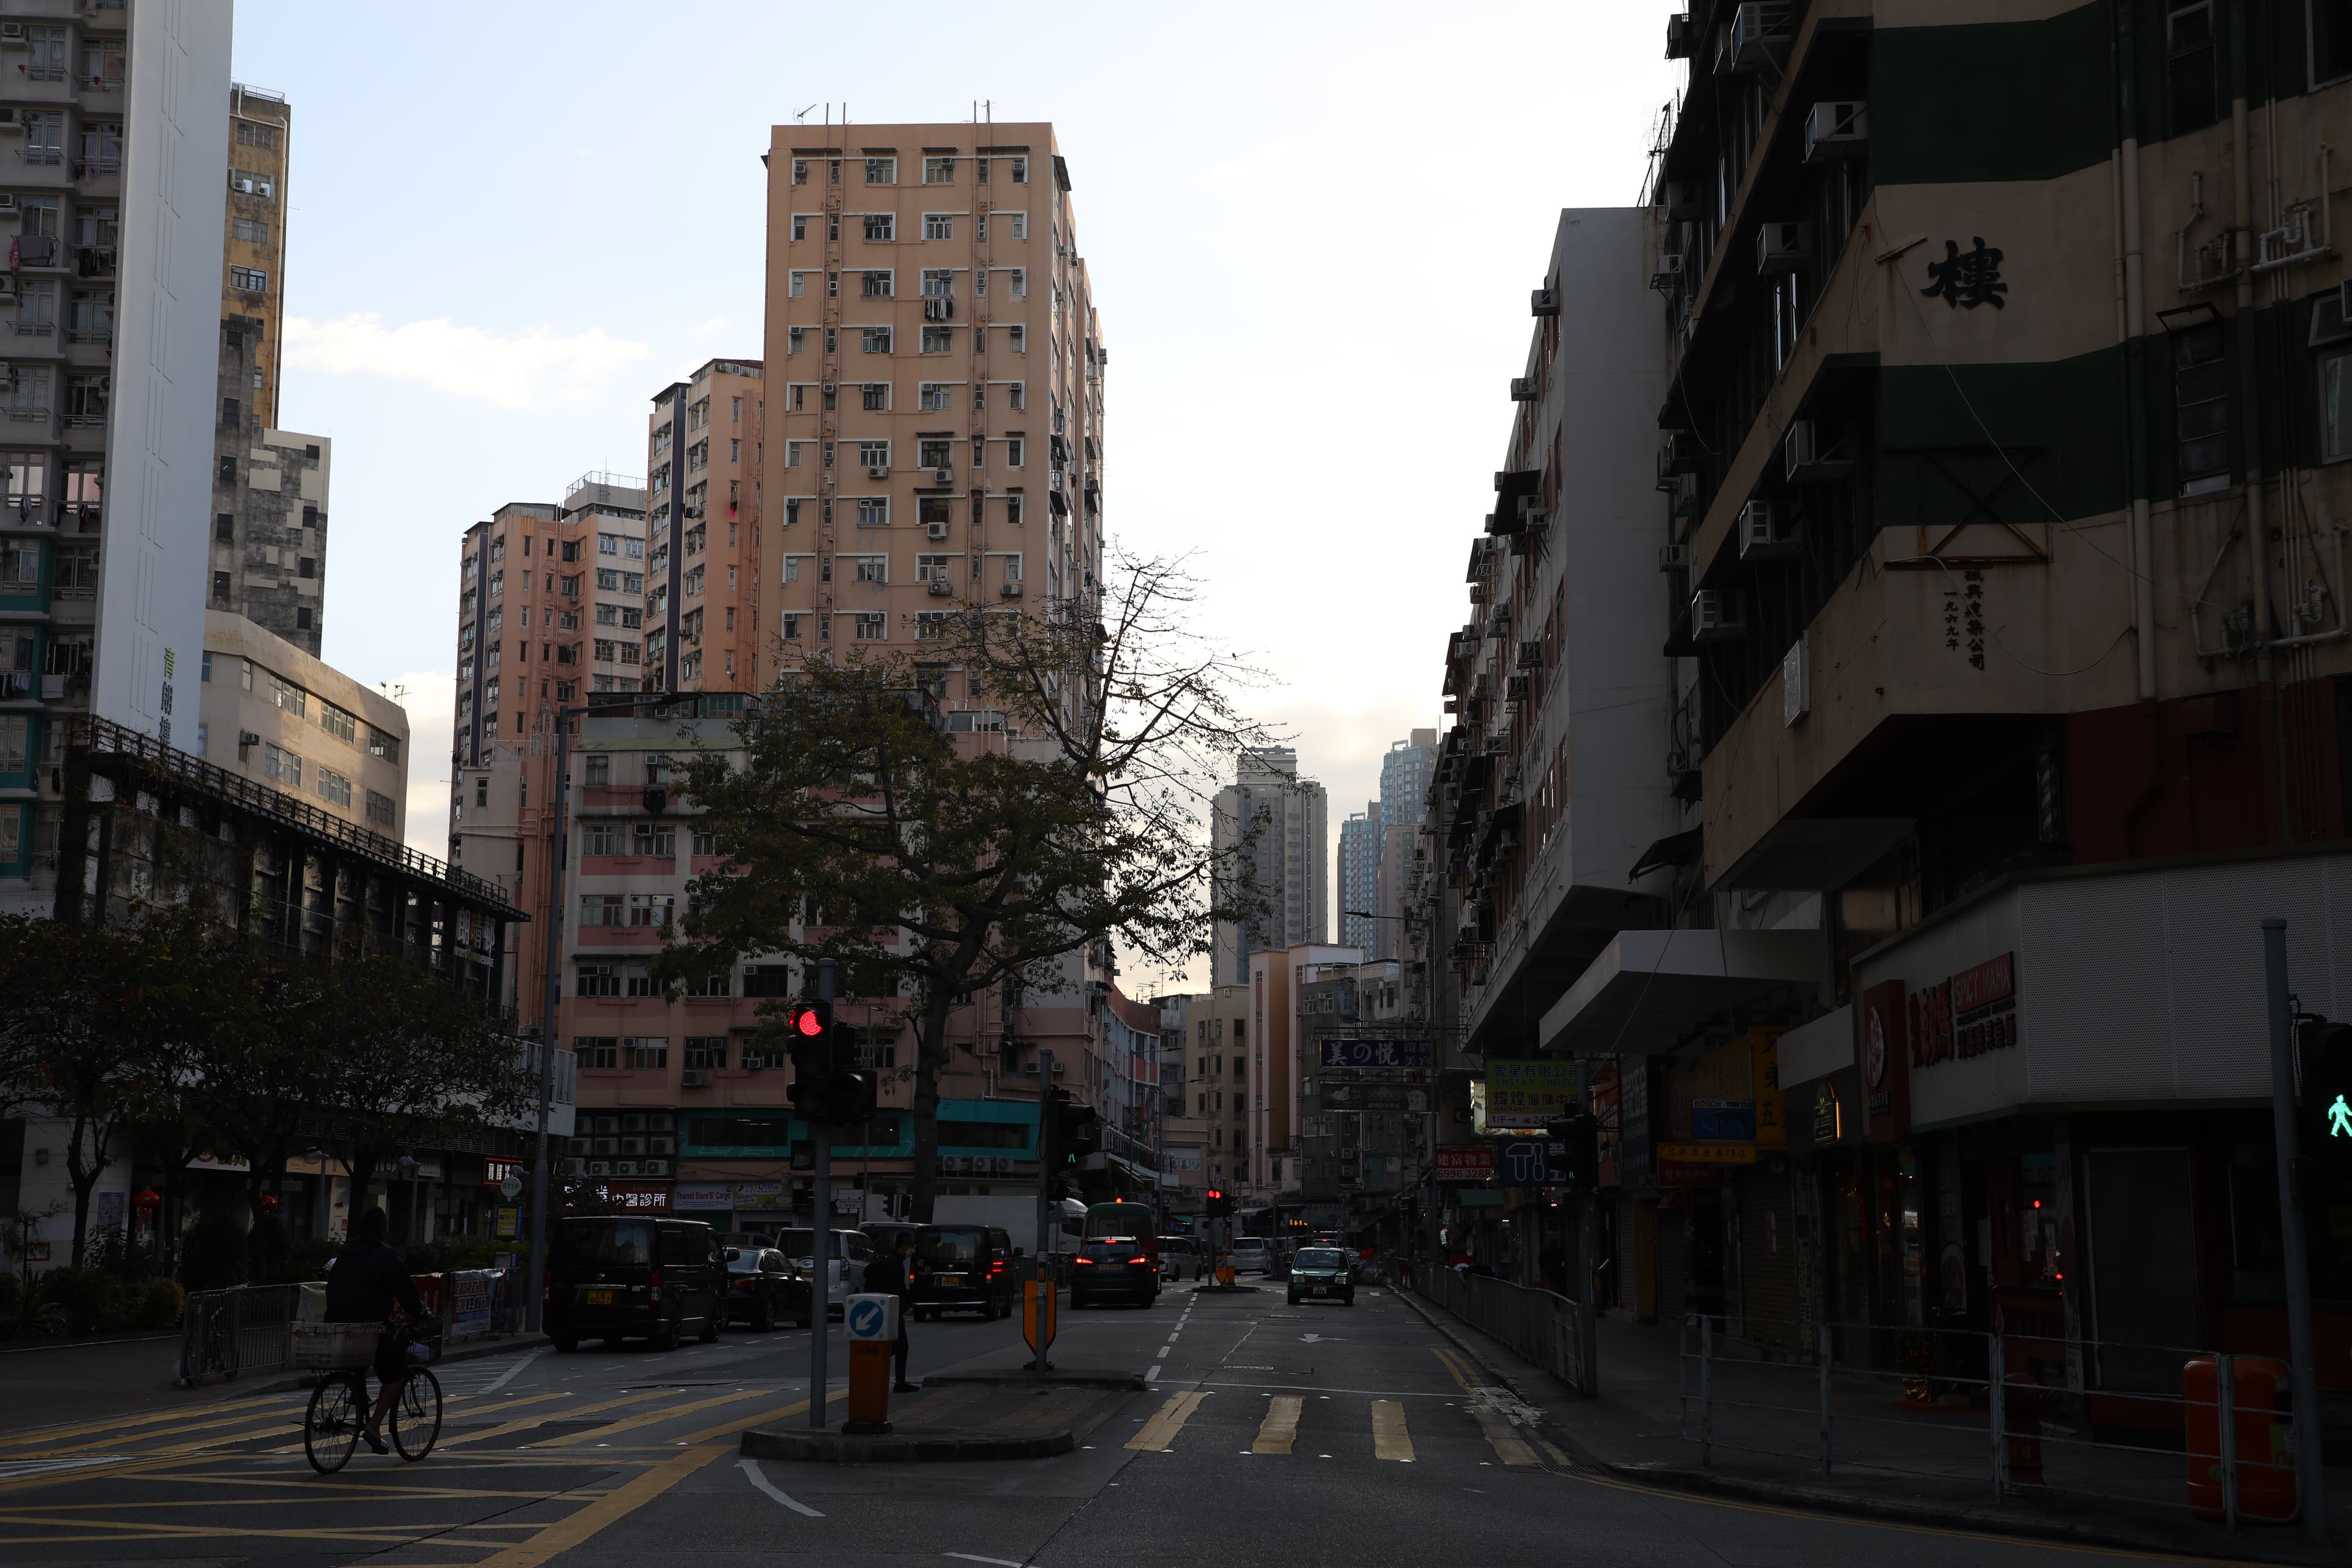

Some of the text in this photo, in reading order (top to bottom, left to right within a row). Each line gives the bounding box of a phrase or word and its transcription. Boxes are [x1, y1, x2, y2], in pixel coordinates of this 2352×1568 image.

[1920, 236, 2008, 310] 樓
[1943, 591, 1959, 651] 一九六九年
[1955, 964, 2011, 1008] SPICY MAMA
[1437, 1170, 1463, 1178] 6996
[715, 1192, 731, 1201] Cargo
